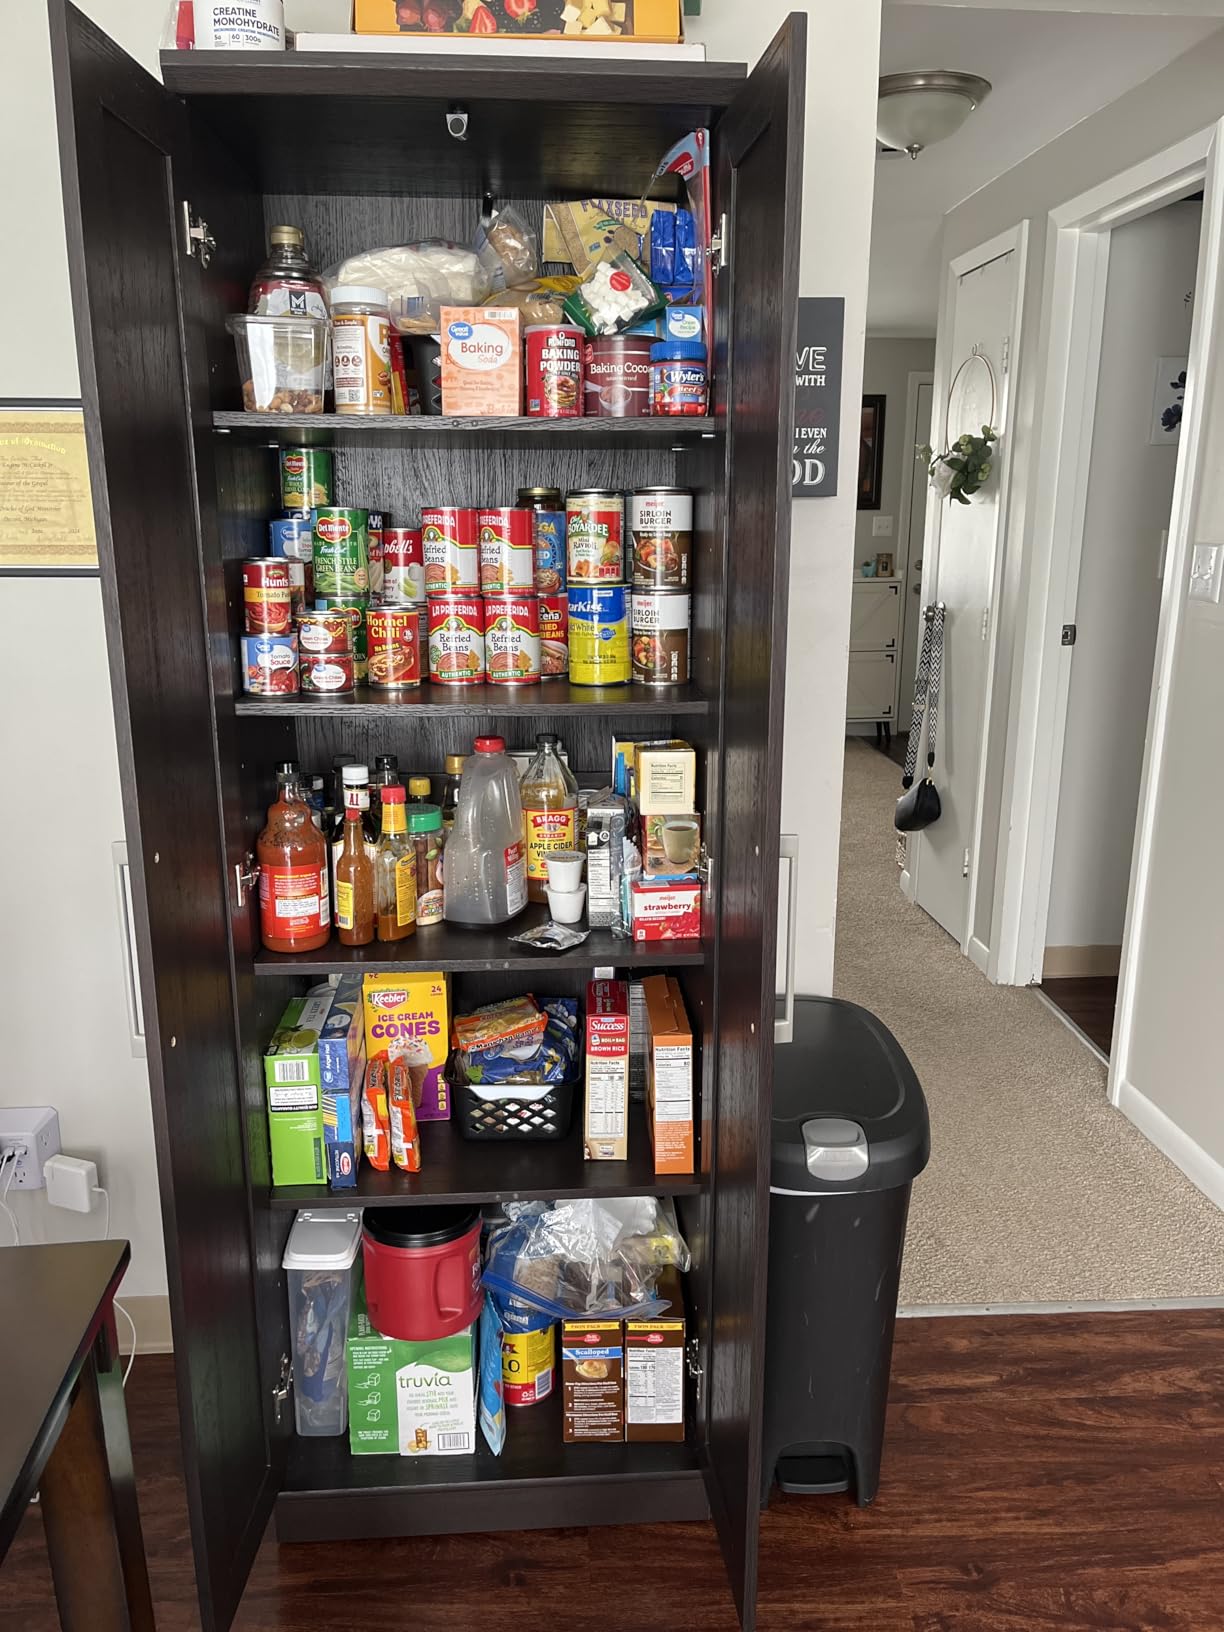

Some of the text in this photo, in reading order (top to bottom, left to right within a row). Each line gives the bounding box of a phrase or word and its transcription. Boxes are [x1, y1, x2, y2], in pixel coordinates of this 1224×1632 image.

[212, 7, 257, 18] CREATINE
[213, 18, 280, 36] MONOHYDRATE
[461, 342, 503, 356] Baking
[542, 348, 580, 360] BAKING
[478, 355, 498, 364] Soda
[540, 360, 580, 372] POWDER
[590, 362, 624, 375] Baking
[624, 362, 650, 374] Coco
[670, 370, 704, 383] Wyler's
[796, 374, 826, 386] WITH
[800, 428, 828, 439] EVEN
[803, 438, 826, 454] the
[318, 524, 349, 532] Del Monte
[320, 546, 334, 554] Fresh
[384, 540, 413, 554] pbell's
[573, 542, 597, 550] Ravioli
[315, 556, 356, 565] FRENCH STYLE
[425, 554, 445, 562] Beans
[316, 564, 356, 572] GREEN BEANS
[257, 590, 280, 598] Tomato
[637, 600, 652, 608] meijer
[432, 604, 478, 617] LA PREFERIDA
[492, 604, 529, 617] PREFERIDA
[366, 615, 407, 628] Hormel
[371, 626, 400, 638] Chili
[440, 634, 471, 643] Refried
[491, 634, 521, 643] Refried
[381, 643, 400, 651] Beans
[442, 642, 469, 652] Beans
[494, 642, 519, 652] Beans
[536, 814, 566, 822] BRAGG
[554, 841, 573, 850] CIDER
[644, 903, 692, 911] strawberry
[374, 994, 405, 1005] Keebler
[378, 1012, 433, 1022] ICE CREAM
[371, 1020, 440, 1038] CONES
[592, 1021, 624, 1030] Success
